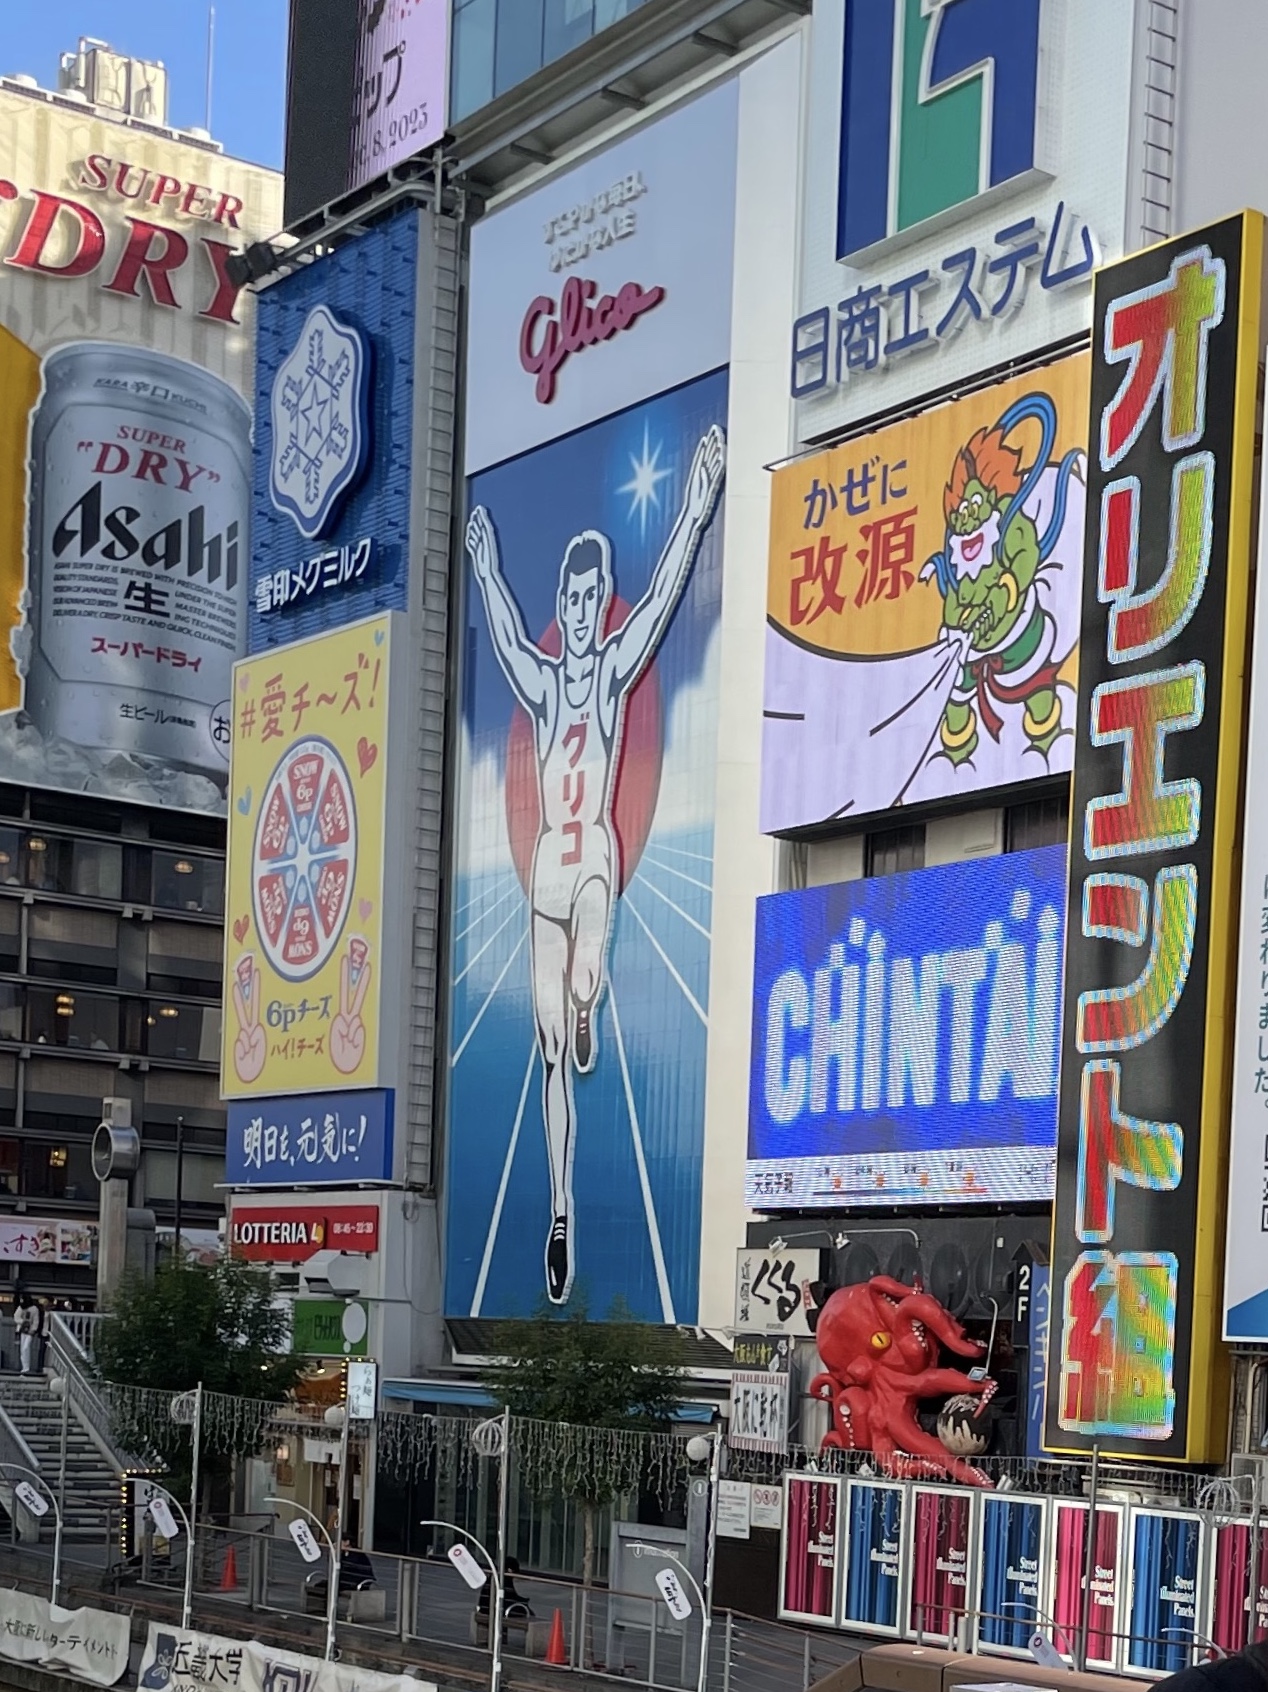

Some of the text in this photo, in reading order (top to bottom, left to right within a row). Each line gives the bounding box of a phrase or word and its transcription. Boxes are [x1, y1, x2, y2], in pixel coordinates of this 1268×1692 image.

[79, 154, 243, 230] SUPER
[791, 201, 1094, 399] 日商エステム
[519, 276, 666, 404] Glico
[117, 425, 186, 454] SUPER
[803, 456, 909, 530] かぜに
[52, 481, 239, 593] Asahi
[789, 506, 919, 627] 改源
[124, 580, 170, 618] 生
[254, 537, 372, 614] 雪印メグミルク
[90, 636, 203, 673] スーパードライ
[561, 711, 591, 868] グリコ
[233, 1221, 307, 1245] LOTTERIA
